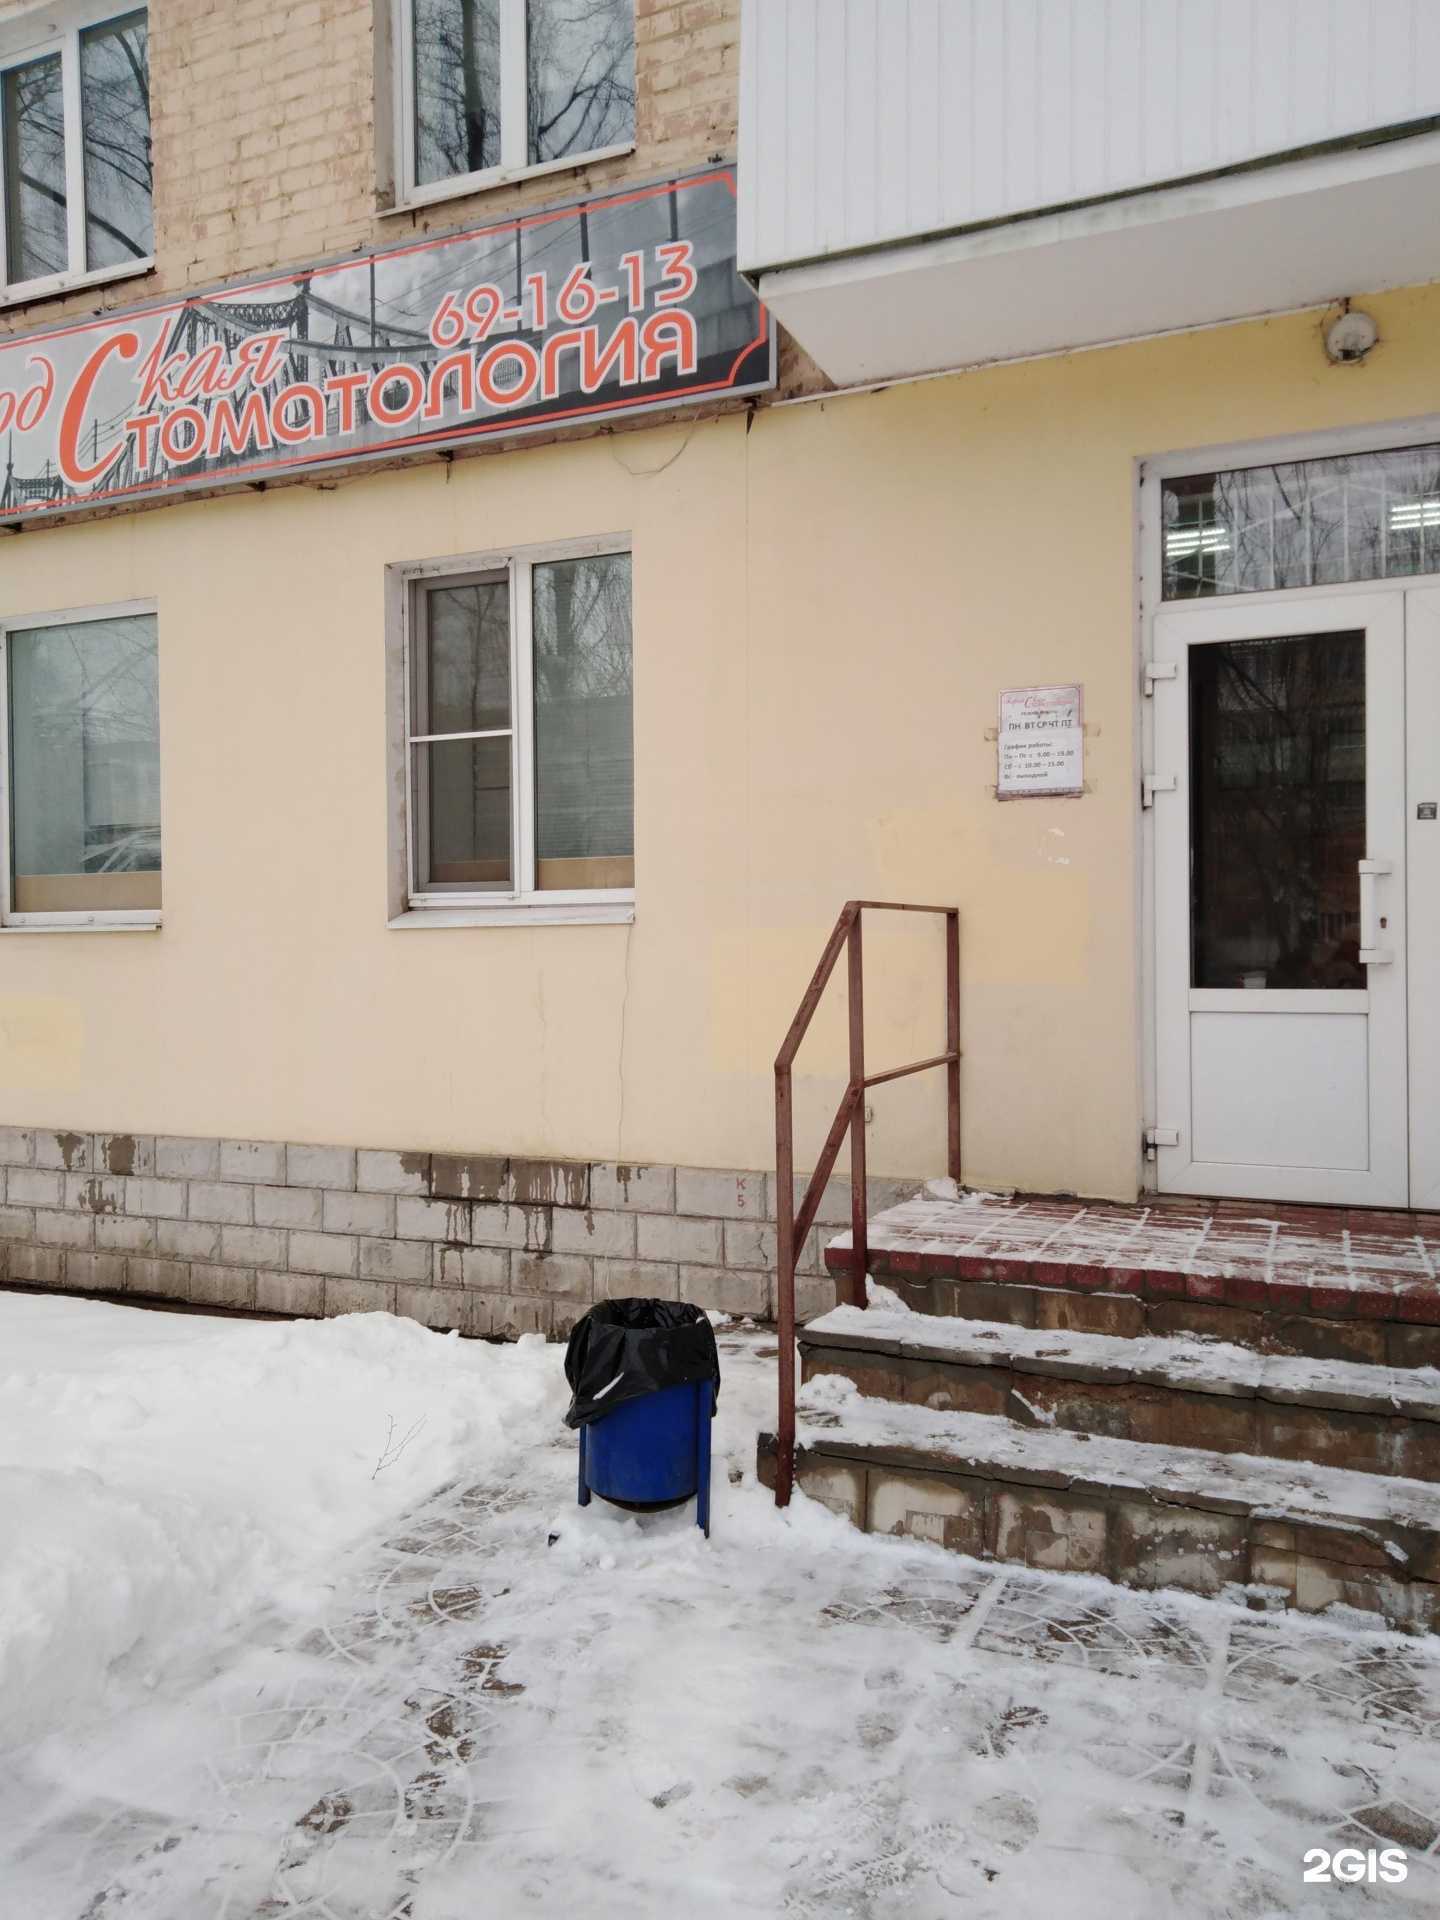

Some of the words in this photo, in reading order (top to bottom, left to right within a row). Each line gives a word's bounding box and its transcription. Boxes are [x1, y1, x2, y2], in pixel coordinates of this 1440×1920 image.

[430, 241, 697, 348] 69-16-13
[1008, 722, 1021, 731] ПН
[1024, 721, 1035, 730] ВТ
[1036, 721, 1048, 729] СР
[1048, 720, 1059, 728] ЧТ
